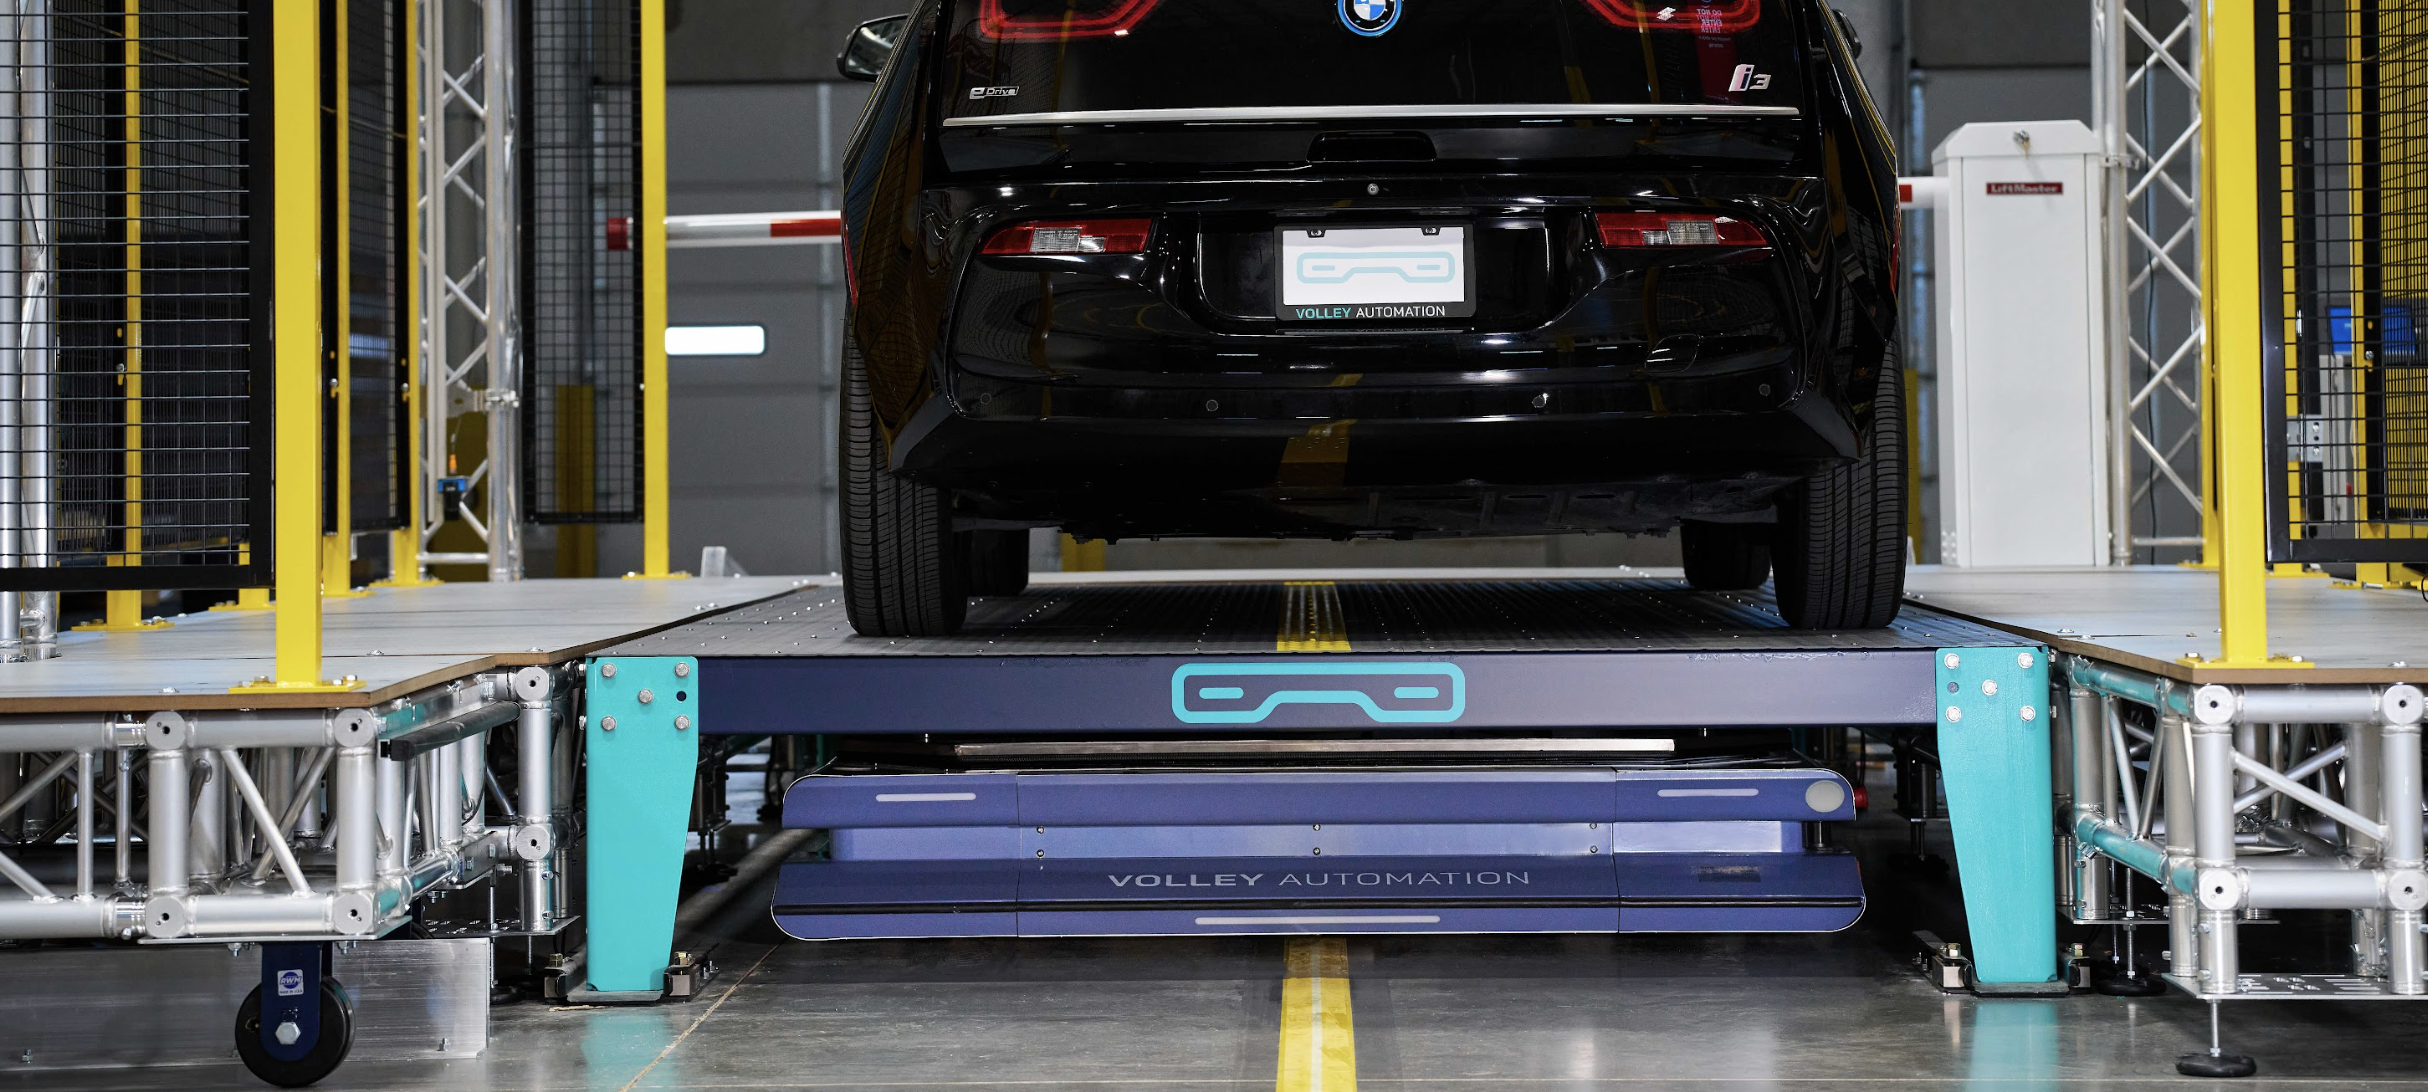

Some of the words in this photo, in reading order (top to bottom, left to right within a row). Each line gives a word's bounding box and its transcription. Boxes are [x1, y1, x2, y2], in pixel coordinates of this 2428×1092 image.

[1728, 63, 1771, 92] i3
[1295, 307, 1351, 319] VOLLEY
[1355, 305, 1446, 318] AUTOMATION
[1107, 873, 1264, 888] VOLLEY
[1278, 871, 1530, 886] AUTOMATION
